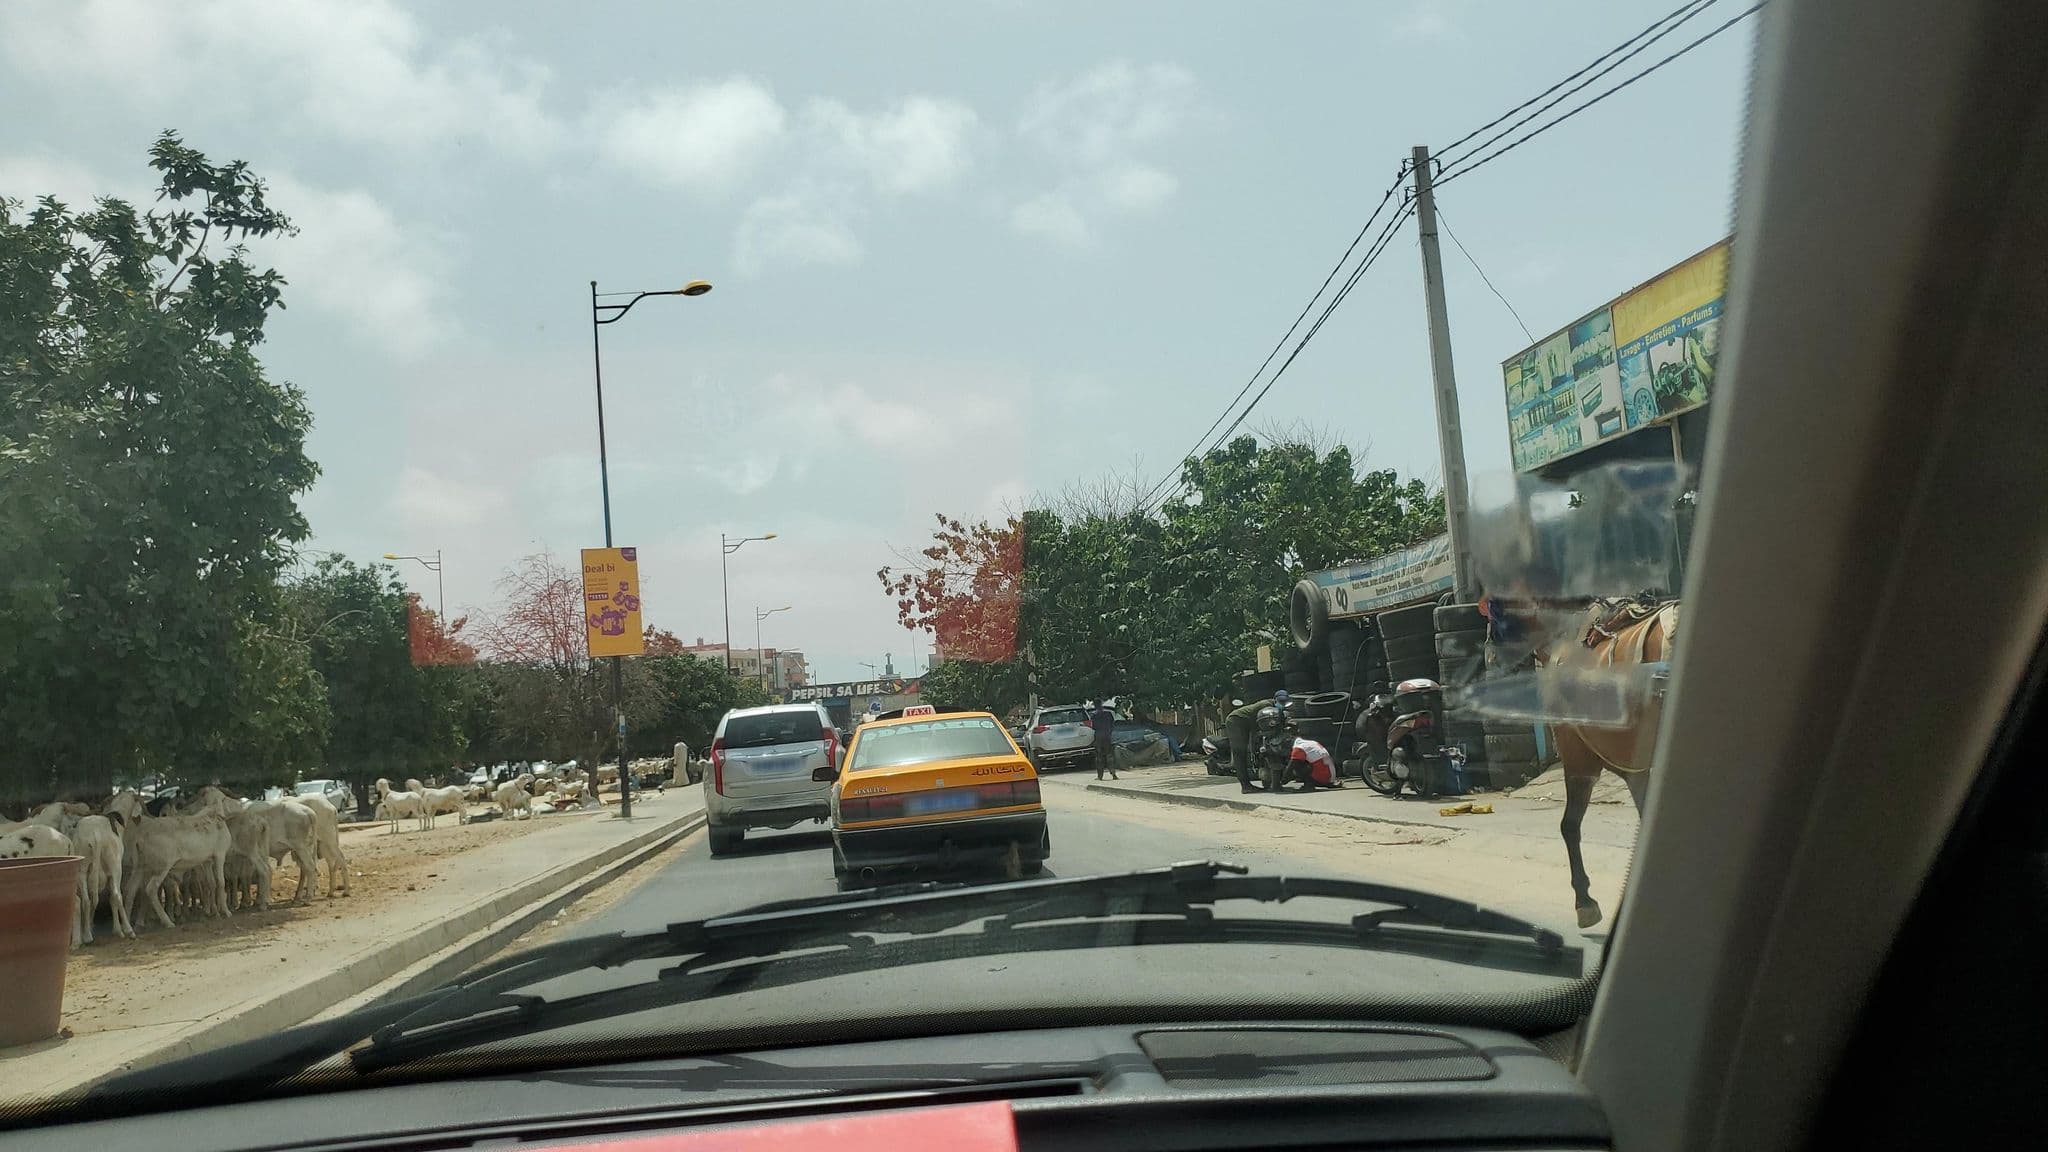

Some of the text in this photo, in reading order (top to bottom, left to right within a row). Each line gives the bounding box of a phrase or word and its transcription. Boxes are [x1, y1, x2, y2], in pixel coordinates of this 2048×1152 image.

[1645, 324, 1676, 344] Entretien
[1681, 306, 1713, 327] Parfums
[585, 564, 605, 574] Deal
[792, 683, 880, 700] PEPSIL SA LIFE
[909, 707, 931, 716] TAXI
